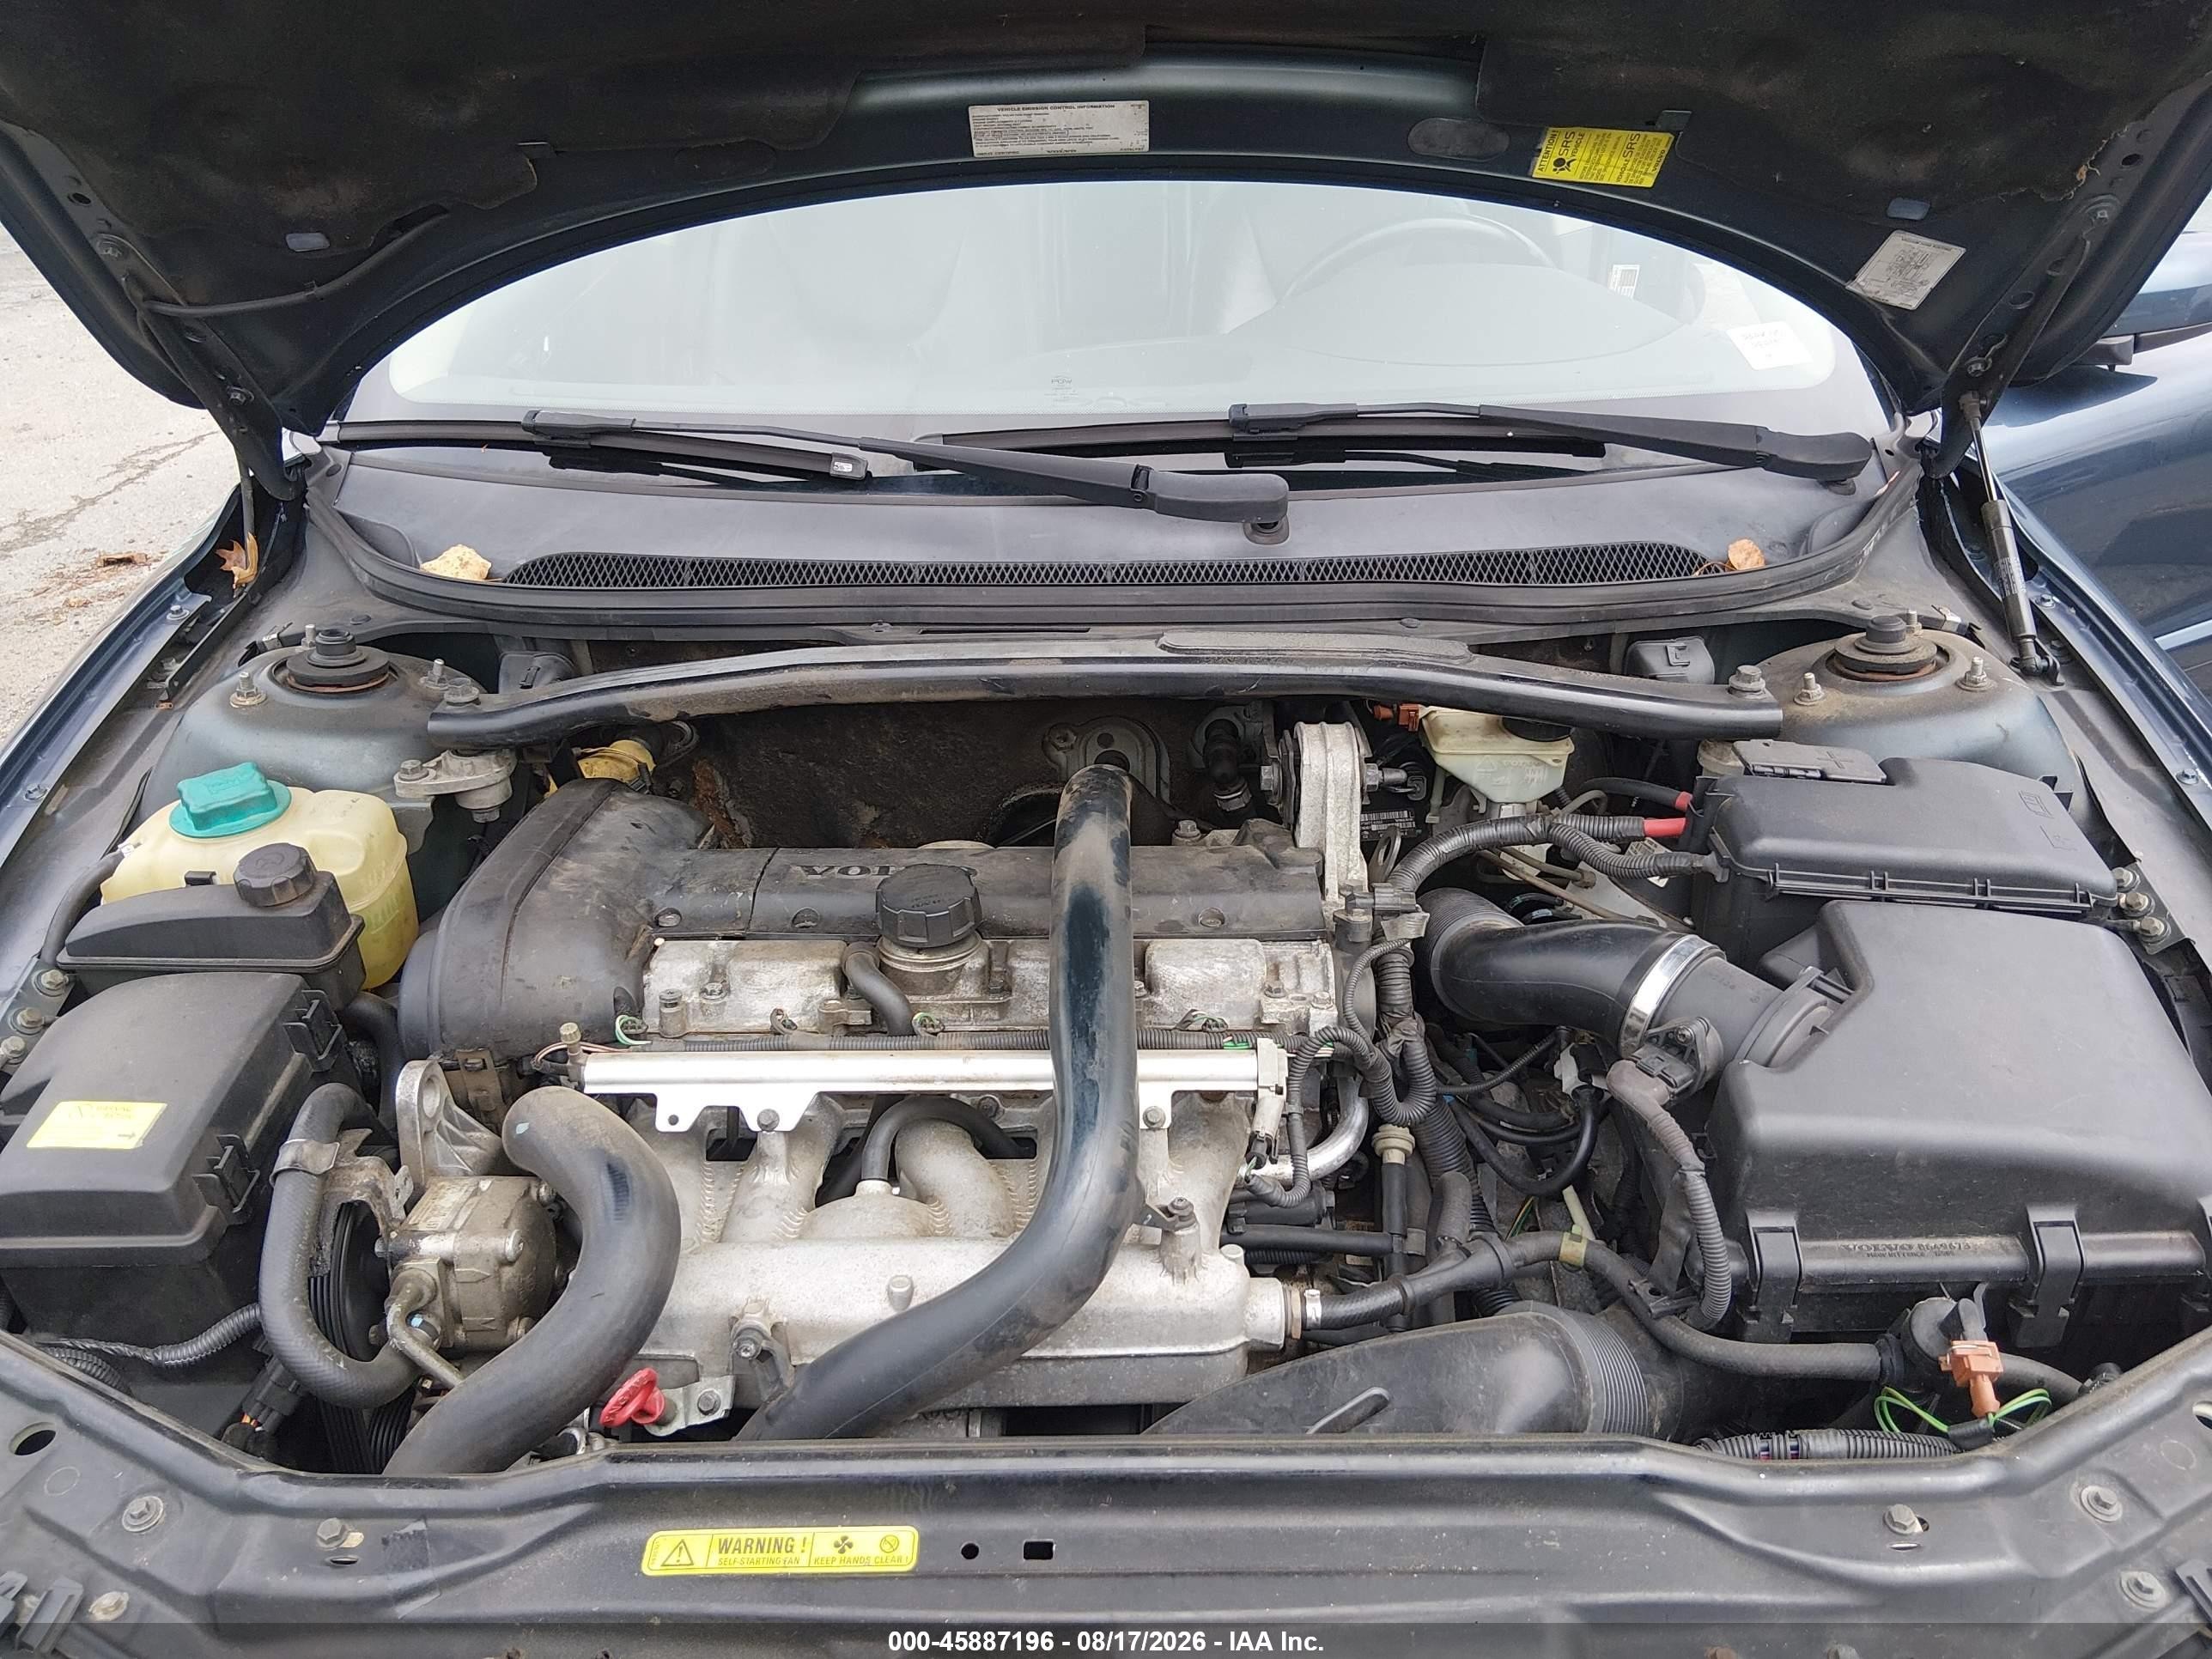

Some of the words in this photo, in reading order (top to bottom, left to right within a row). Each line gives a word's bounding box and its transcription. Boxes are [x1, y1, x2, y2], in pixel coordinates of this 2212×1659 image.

[1559, 131, 1576, 156] SRS
[1570, 133, 1585, 158] VEHICLE
[1622, 133, 1641, 158] SRS
[1652, 149, 1666, 172] VOLVO
[718, 1536, 795, 1554] WARNING
[718, 1556, 781, 1566] SELF-STARTING
[783, 1556, 800, 1565] FAN
[813, 1556, 836, 1565] KEEP
[839, 1555, 871, 1565] HANDS
[874, 1555, 902, 1565] CLEAR
